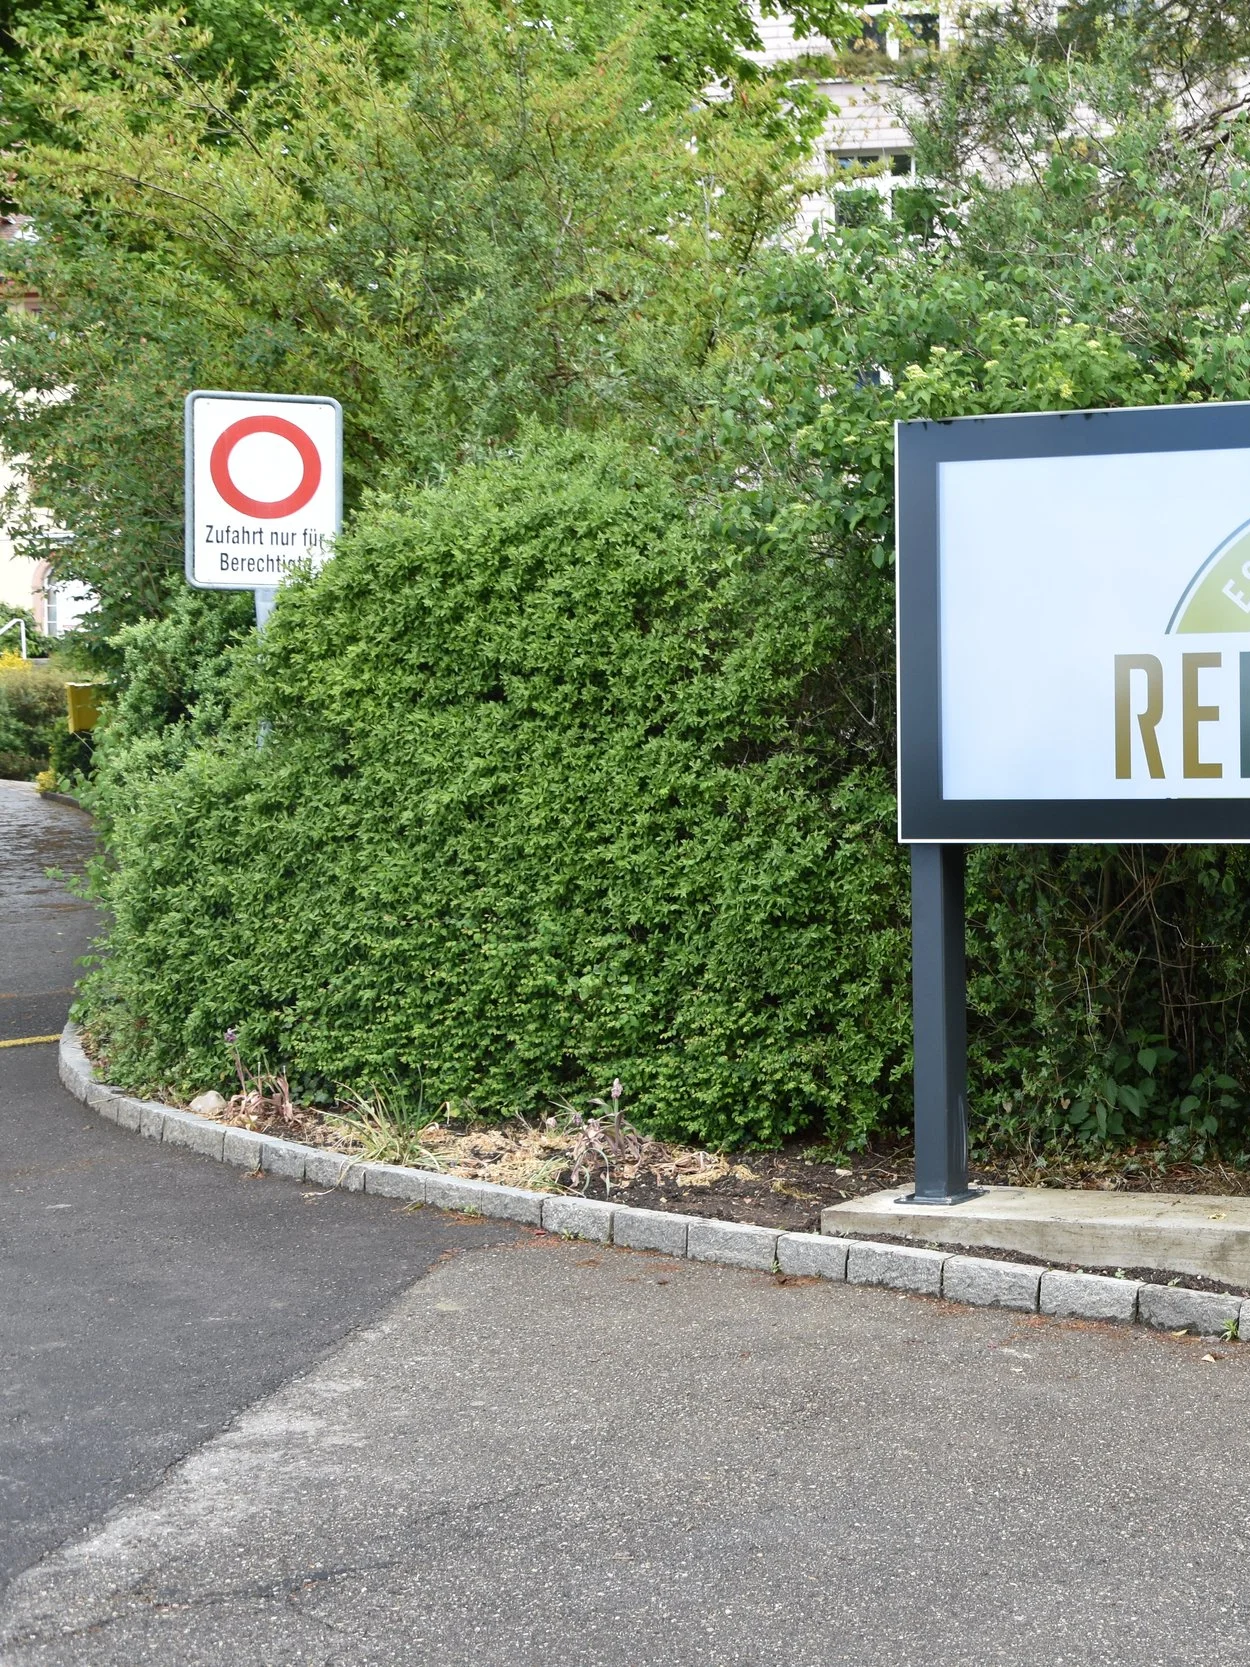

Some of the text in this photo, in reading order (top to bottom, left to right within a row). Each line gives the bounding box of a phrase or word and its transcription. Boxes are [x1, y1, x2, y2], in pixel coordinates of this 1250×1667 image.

[205, 524, 325, 547] Zufahrt nur für
